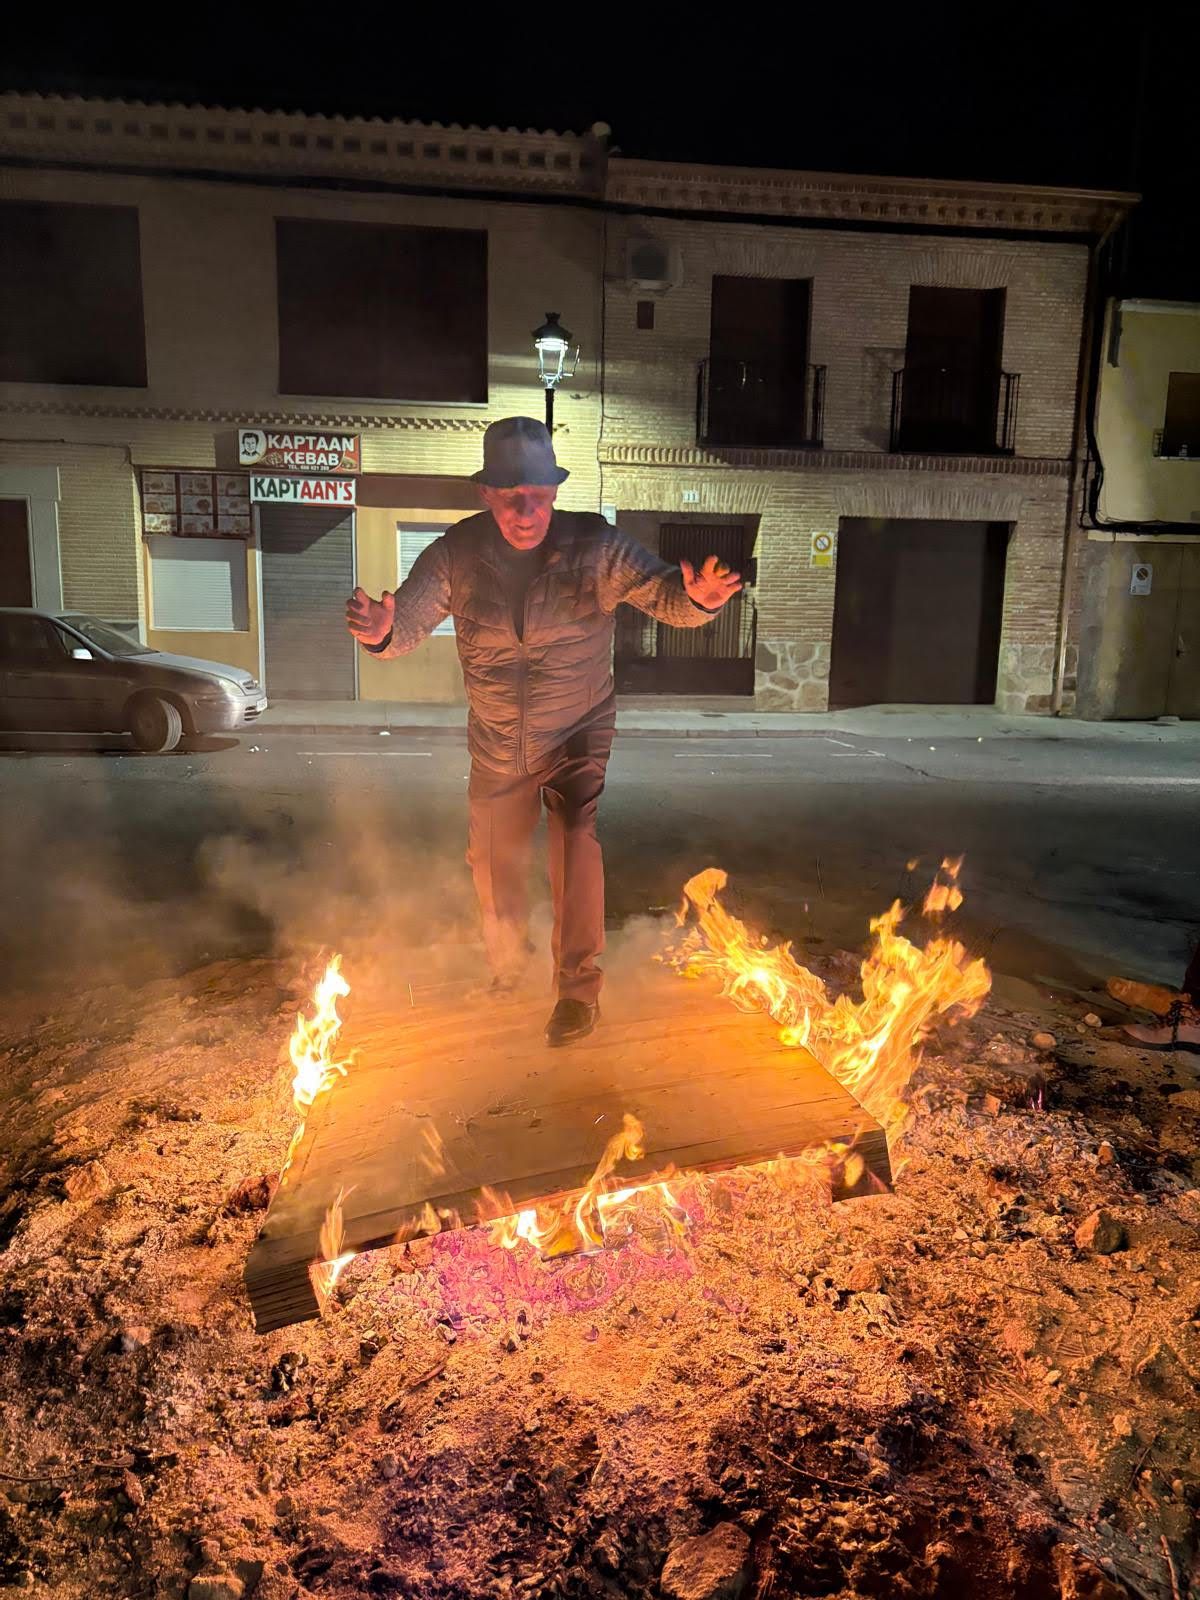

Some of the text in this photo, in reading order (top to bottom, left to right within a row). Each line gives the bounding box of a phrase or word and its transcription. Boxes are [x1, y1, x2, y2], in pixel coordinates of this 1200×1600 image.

[267, 434, 355, 452] KAPTAAN
[283, 451, 339, 466] KEBAB
[254, 477, 353, 501] KAPTAAN'S
